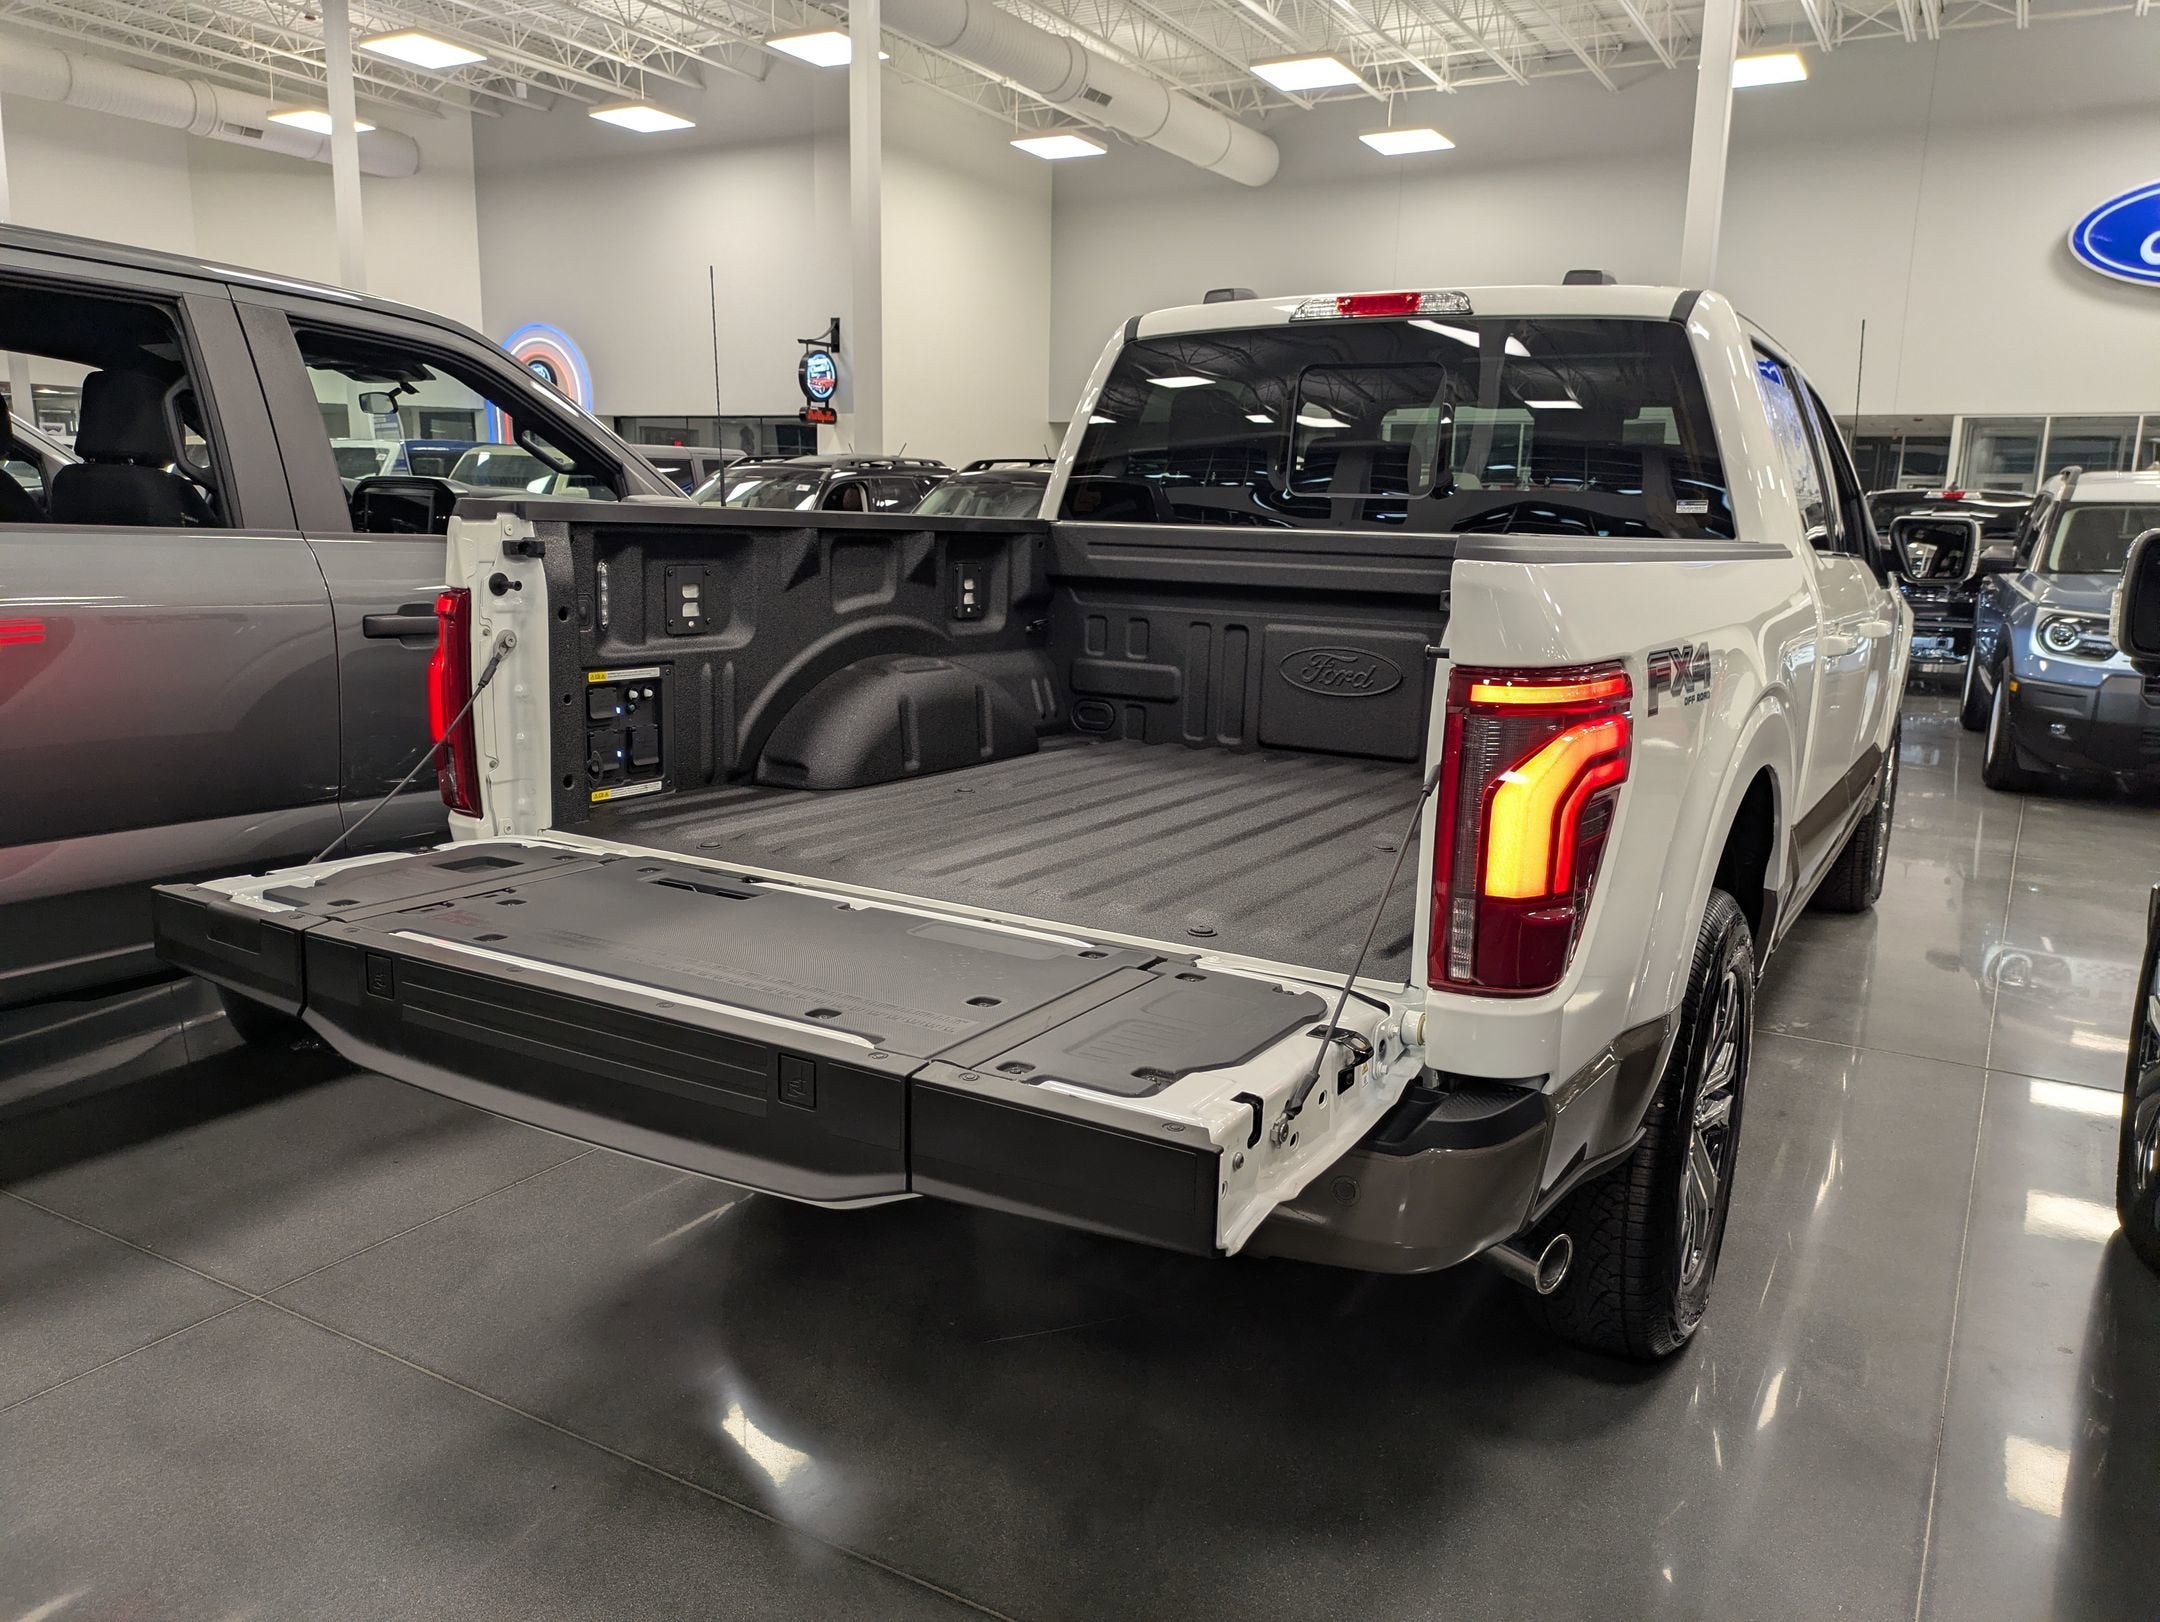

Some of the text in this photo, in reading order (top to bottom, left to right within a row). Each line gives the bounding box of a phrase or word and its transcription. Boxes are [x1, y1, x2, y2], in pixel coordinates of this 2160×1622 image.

[1301, 652, 1377, 689] Ford
[1647, 642, 1711, 717] FX4
[1684, 691, 1711, 706] OFF ROAD
